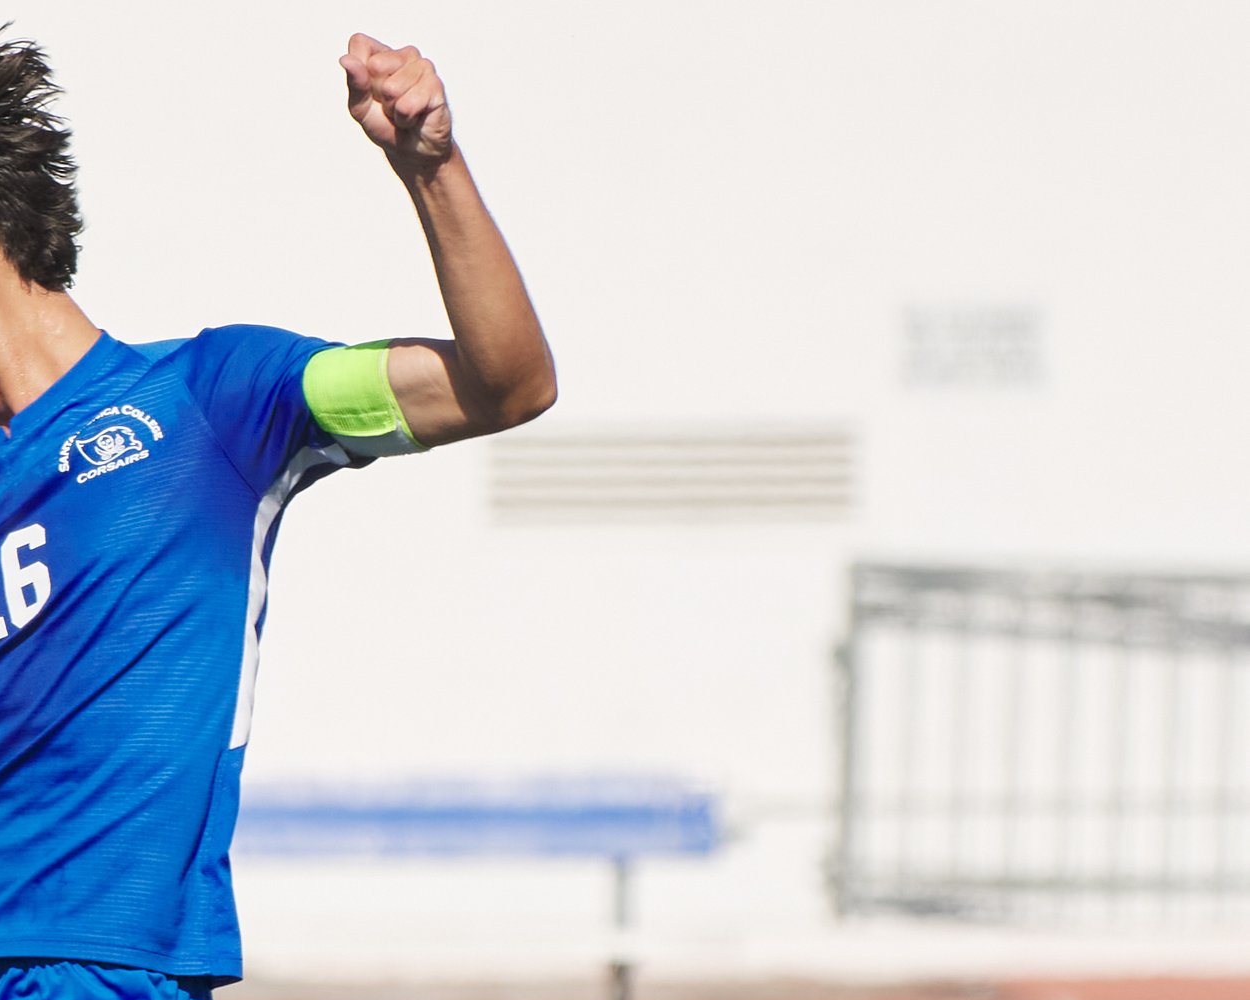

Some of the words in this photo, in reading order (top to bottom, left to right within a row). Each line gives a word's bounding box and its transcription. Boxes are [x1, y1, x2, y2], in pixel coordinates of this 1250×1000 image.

[58, 434, 77, 472] SANTA
[121, 405, 164, 441] COLLEGE
[77, 449, 149, 484] CORSAIRS
